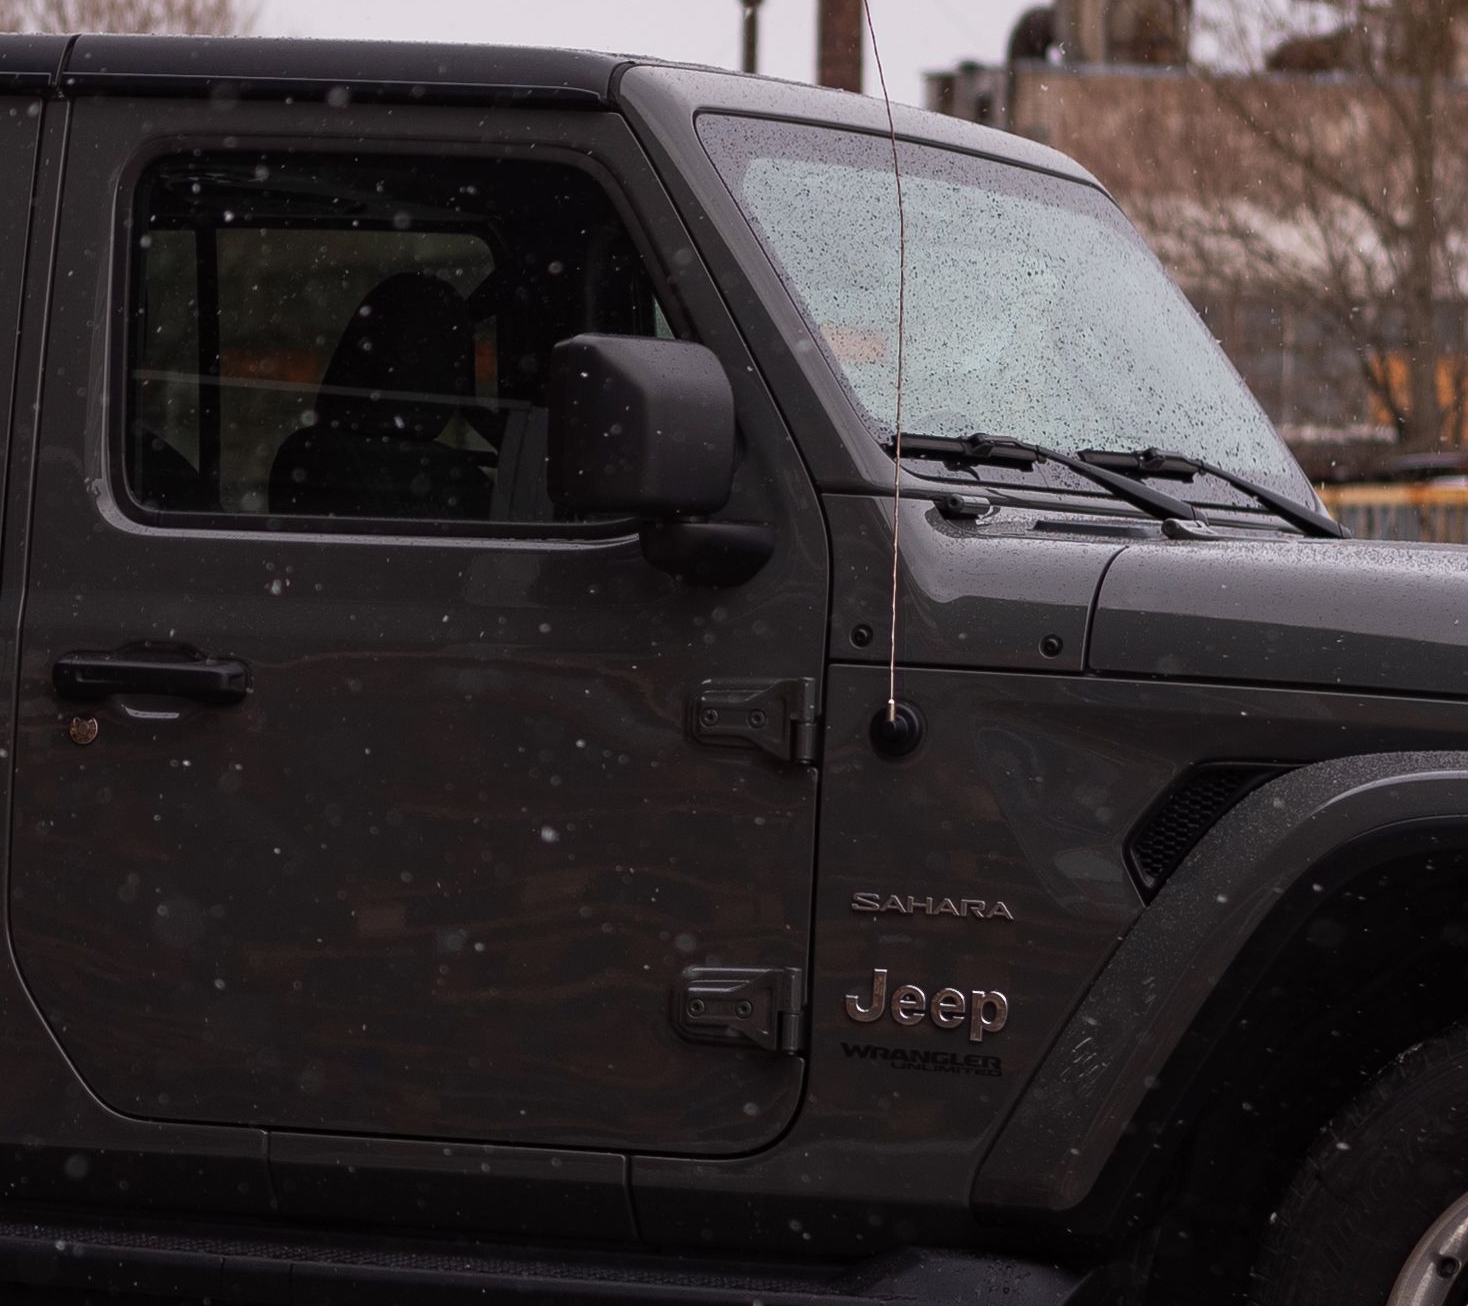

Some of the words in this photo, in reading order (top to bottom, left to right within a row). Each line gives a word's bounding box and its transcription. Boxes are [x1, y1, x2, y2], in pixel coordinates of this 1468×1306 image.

[851, 892, 1014, 920] SAHARA
[845, 968, 1009, 1042] Jeep
[839, 1041, 1002, 1070] WRANGLER
[890, 1060, 1003, 1078] UNLIMITED
